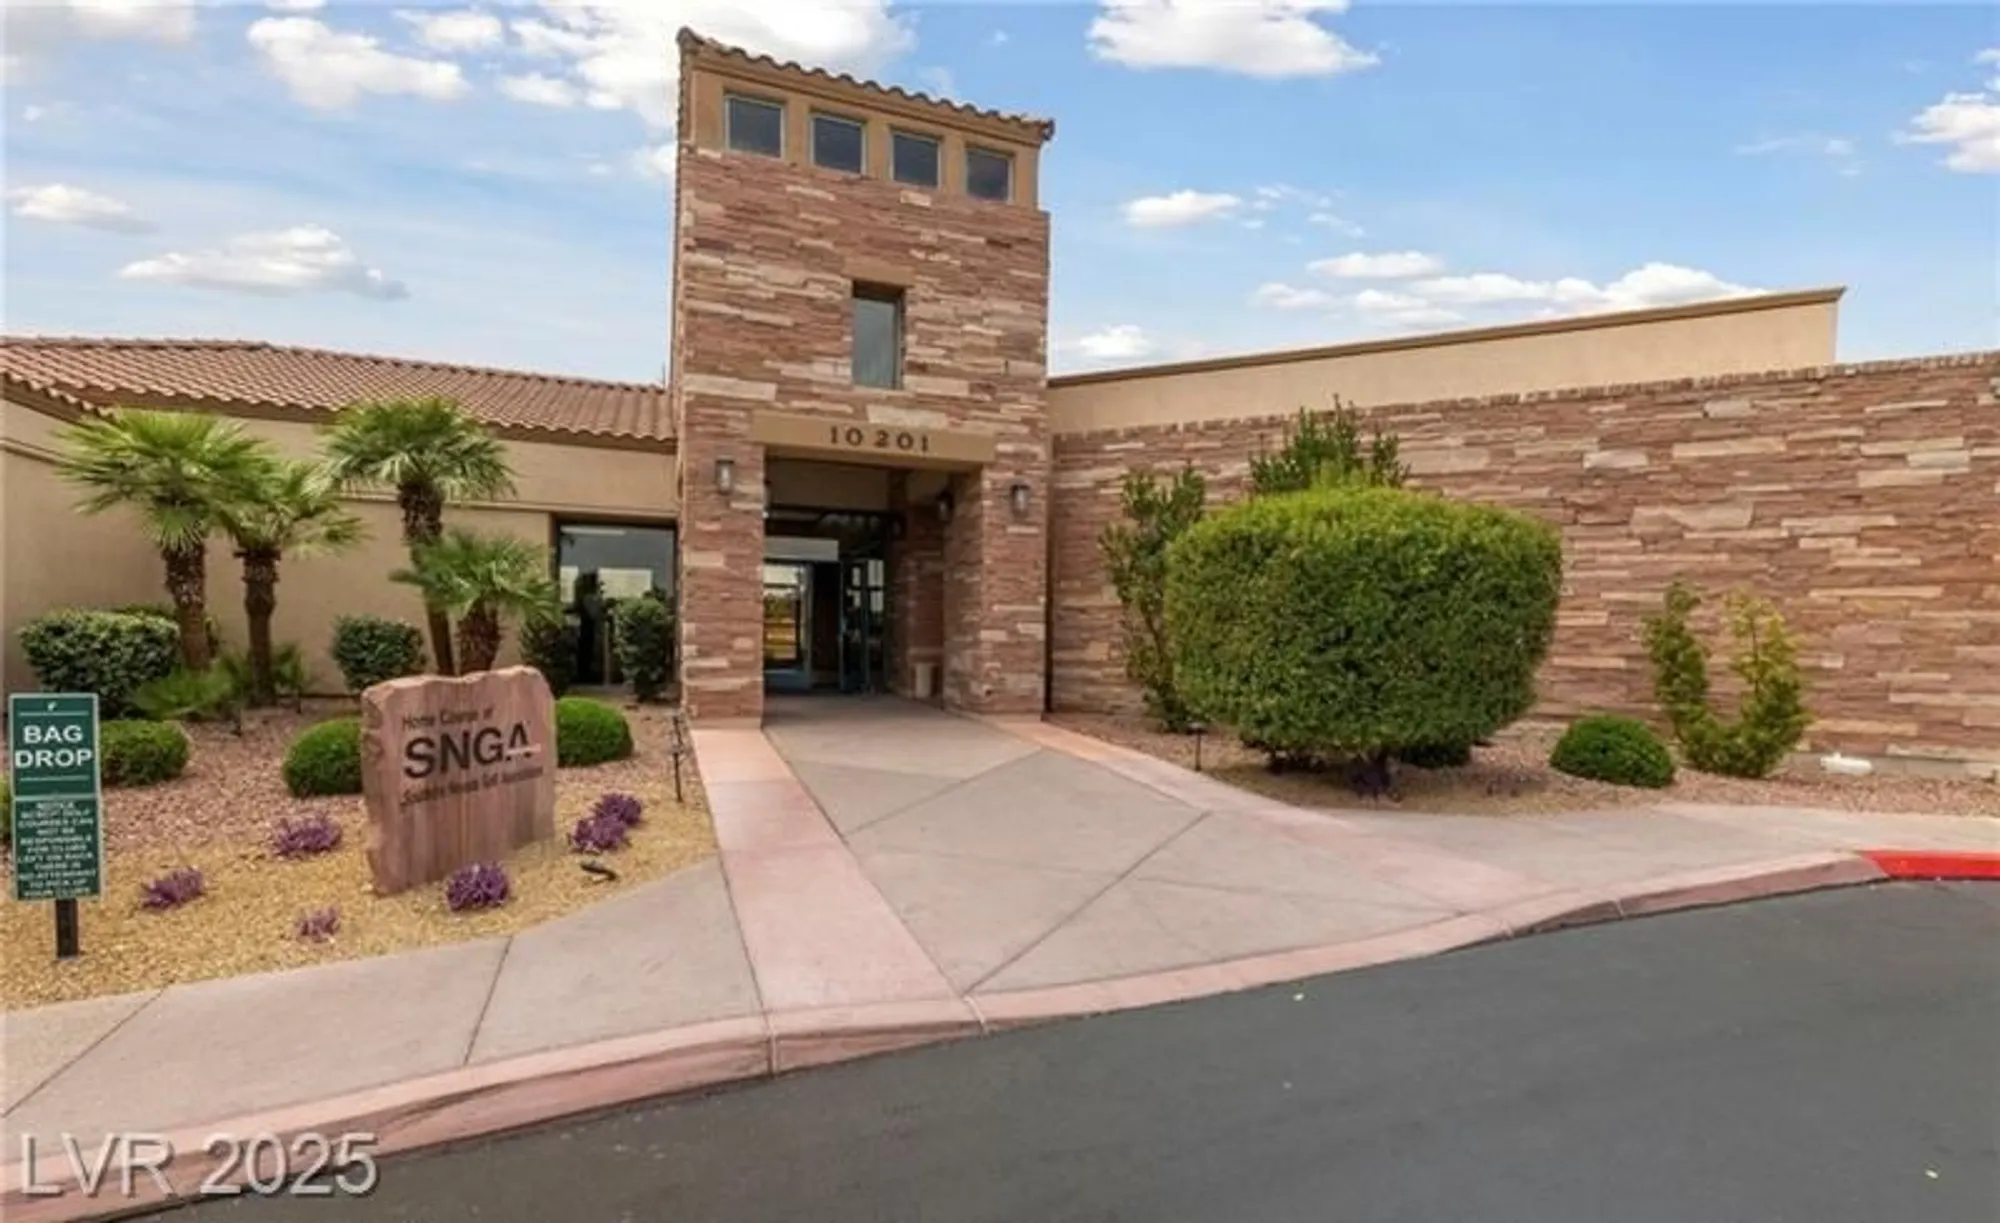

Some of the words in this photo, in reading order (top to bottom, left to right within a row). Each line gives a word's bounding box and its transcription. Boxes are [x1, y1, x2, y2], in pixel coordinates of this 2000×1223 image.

[23, 724, 83, 744] BAG
[14, 749, 93, 769] DROP
[403, 720, 532, 779] SNGA
